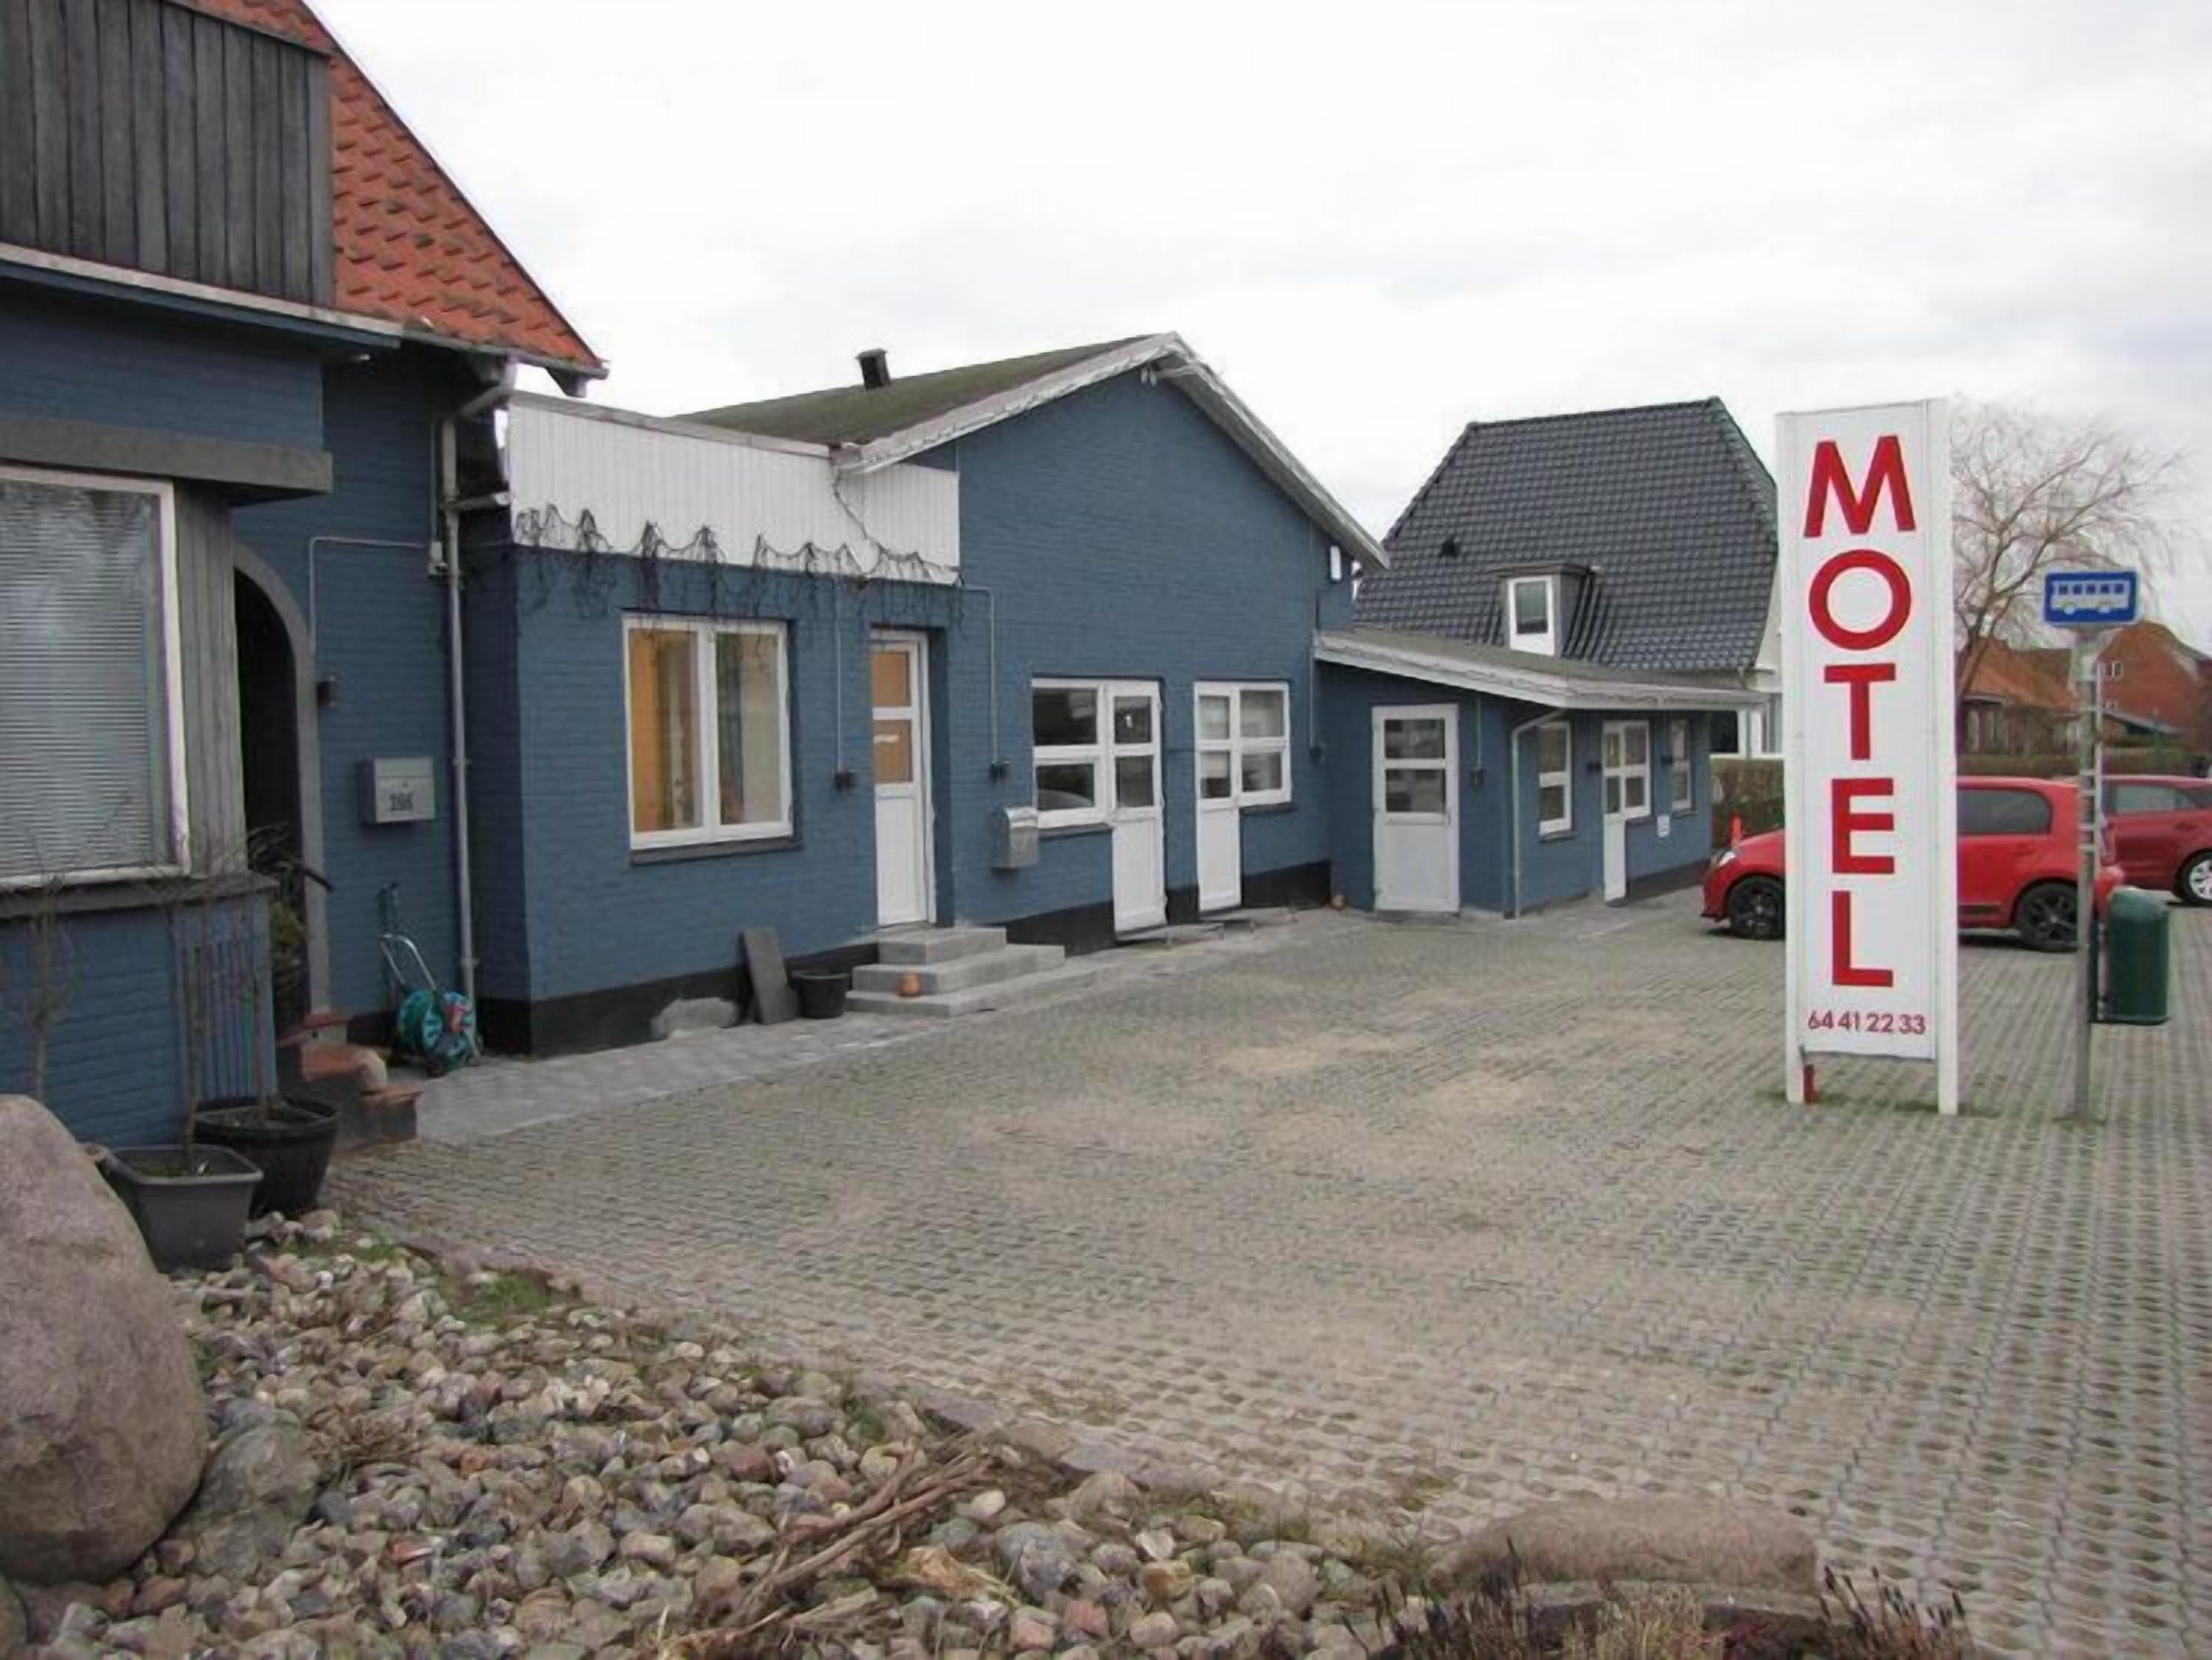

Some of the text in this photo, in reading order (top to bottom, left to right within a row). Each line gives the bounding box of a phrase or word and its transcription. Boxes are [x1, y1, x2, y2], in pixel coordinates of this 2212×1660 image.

[1804, 434, 1916, 988] MOTEL
[1808, 1010, 1927, 1036] 64 41 22 33
